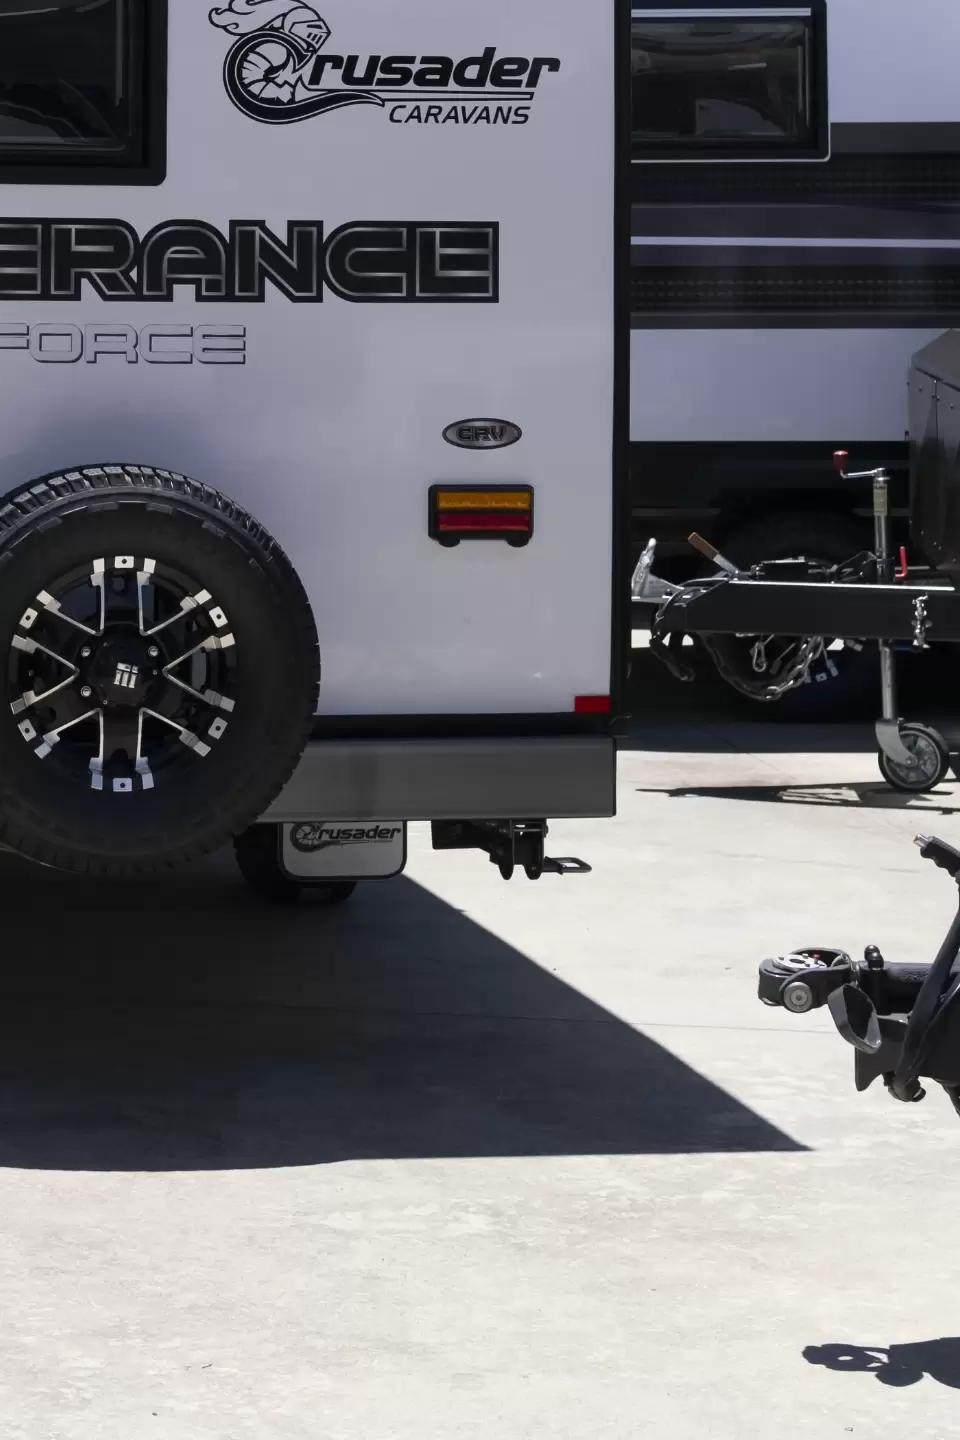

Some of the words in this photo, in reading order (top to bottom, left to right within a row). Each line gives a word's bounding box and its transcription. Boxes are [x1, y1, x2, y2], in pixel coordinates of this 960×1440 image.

[223, 29, 561, 125] Crusader
[389, 104, 532, 125] CARAVANS
[456, 425, 507, 442] CRV
